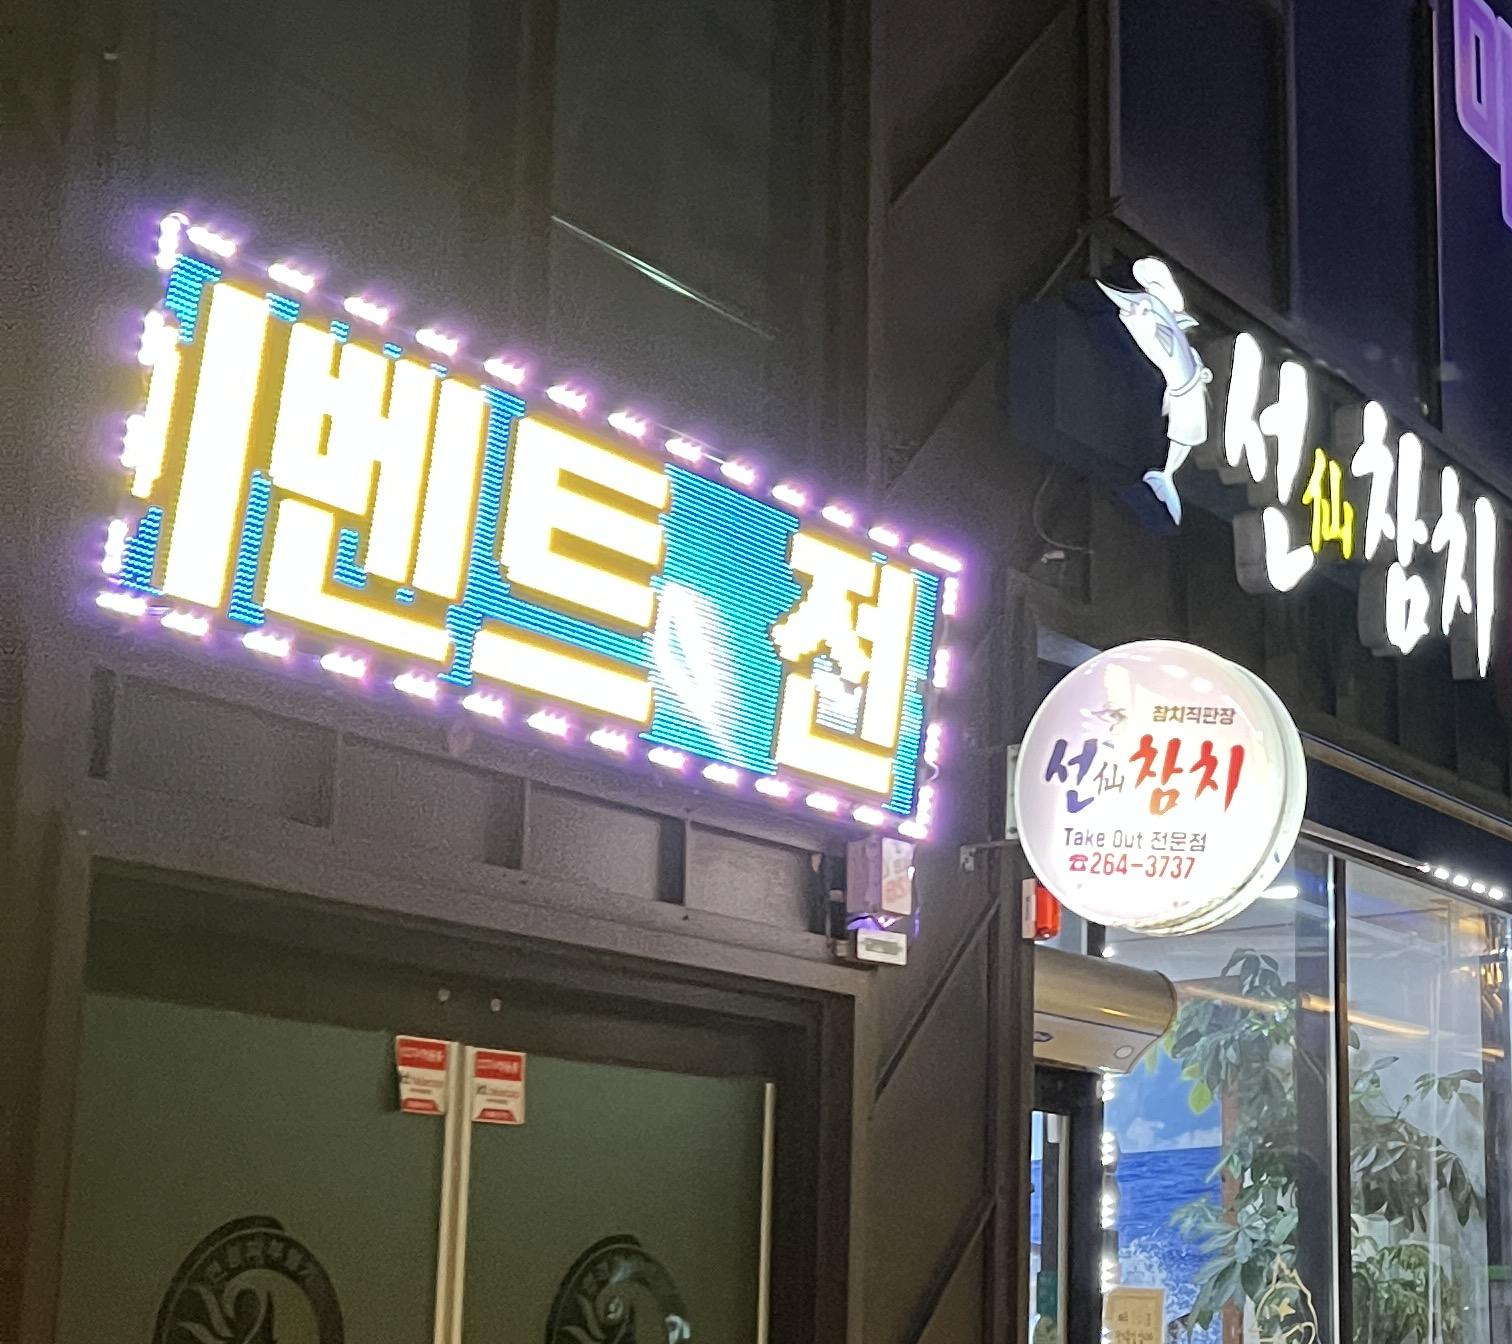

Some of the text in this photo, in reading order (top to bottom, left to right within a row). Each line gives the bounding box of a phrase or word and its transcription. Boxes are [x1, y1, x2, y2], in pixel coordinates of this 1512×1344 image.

[1152, 706, 1237, 725] 참치직판장
[1064, 828, 1208, 852] Take Out 전문점
